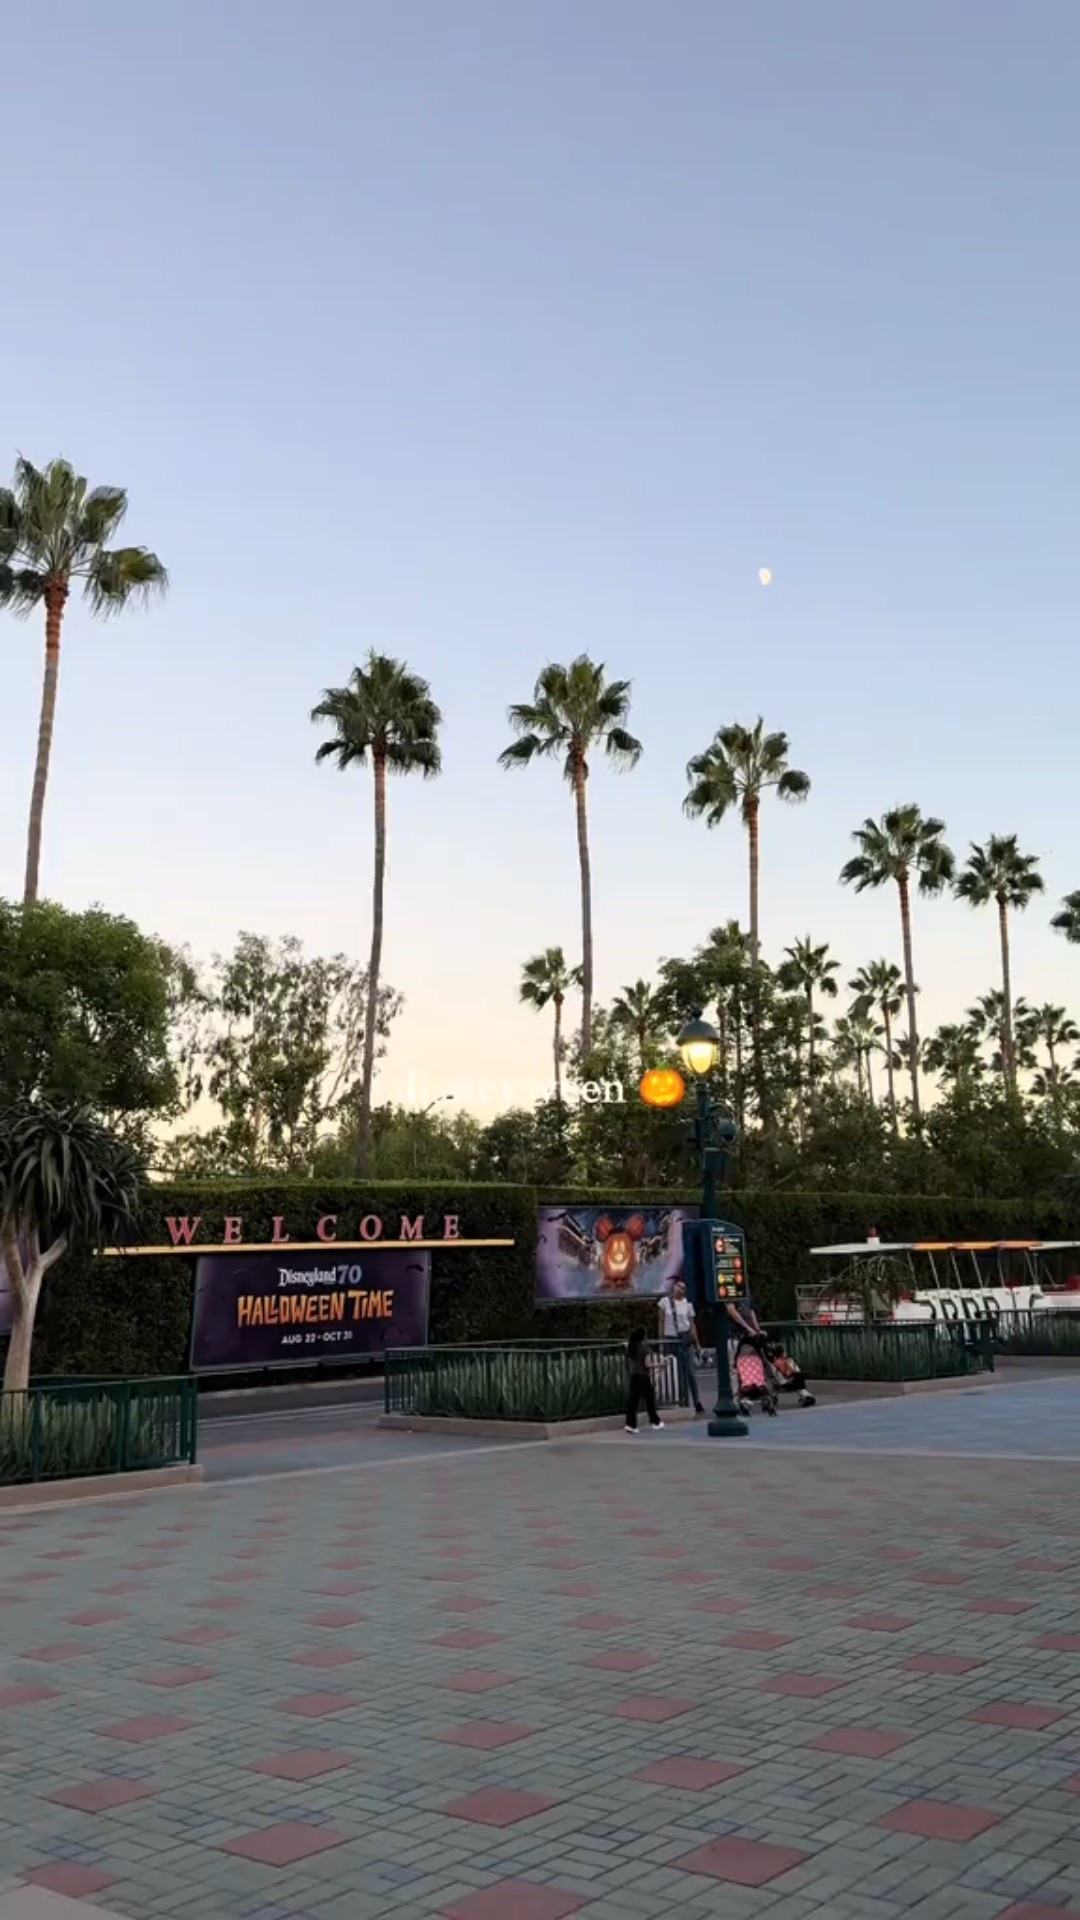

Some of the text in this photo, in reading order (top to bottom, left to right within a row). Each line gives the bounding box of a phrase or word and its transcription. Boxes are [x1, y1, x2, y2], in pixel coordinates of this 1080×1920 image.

[165, 1215, 460, 1245] WELCOME
[277, 1265, 362, 1286] Disneyland 70
[237, 1289, 395, 1328] HALLOWEEN TIME
[281, 1333, 303, 1345] AUG
[304, 1331, 316, 1344] 22
[322, 1331, 342, 1342] OCT
[343, 1330, 353, 1340] 31
